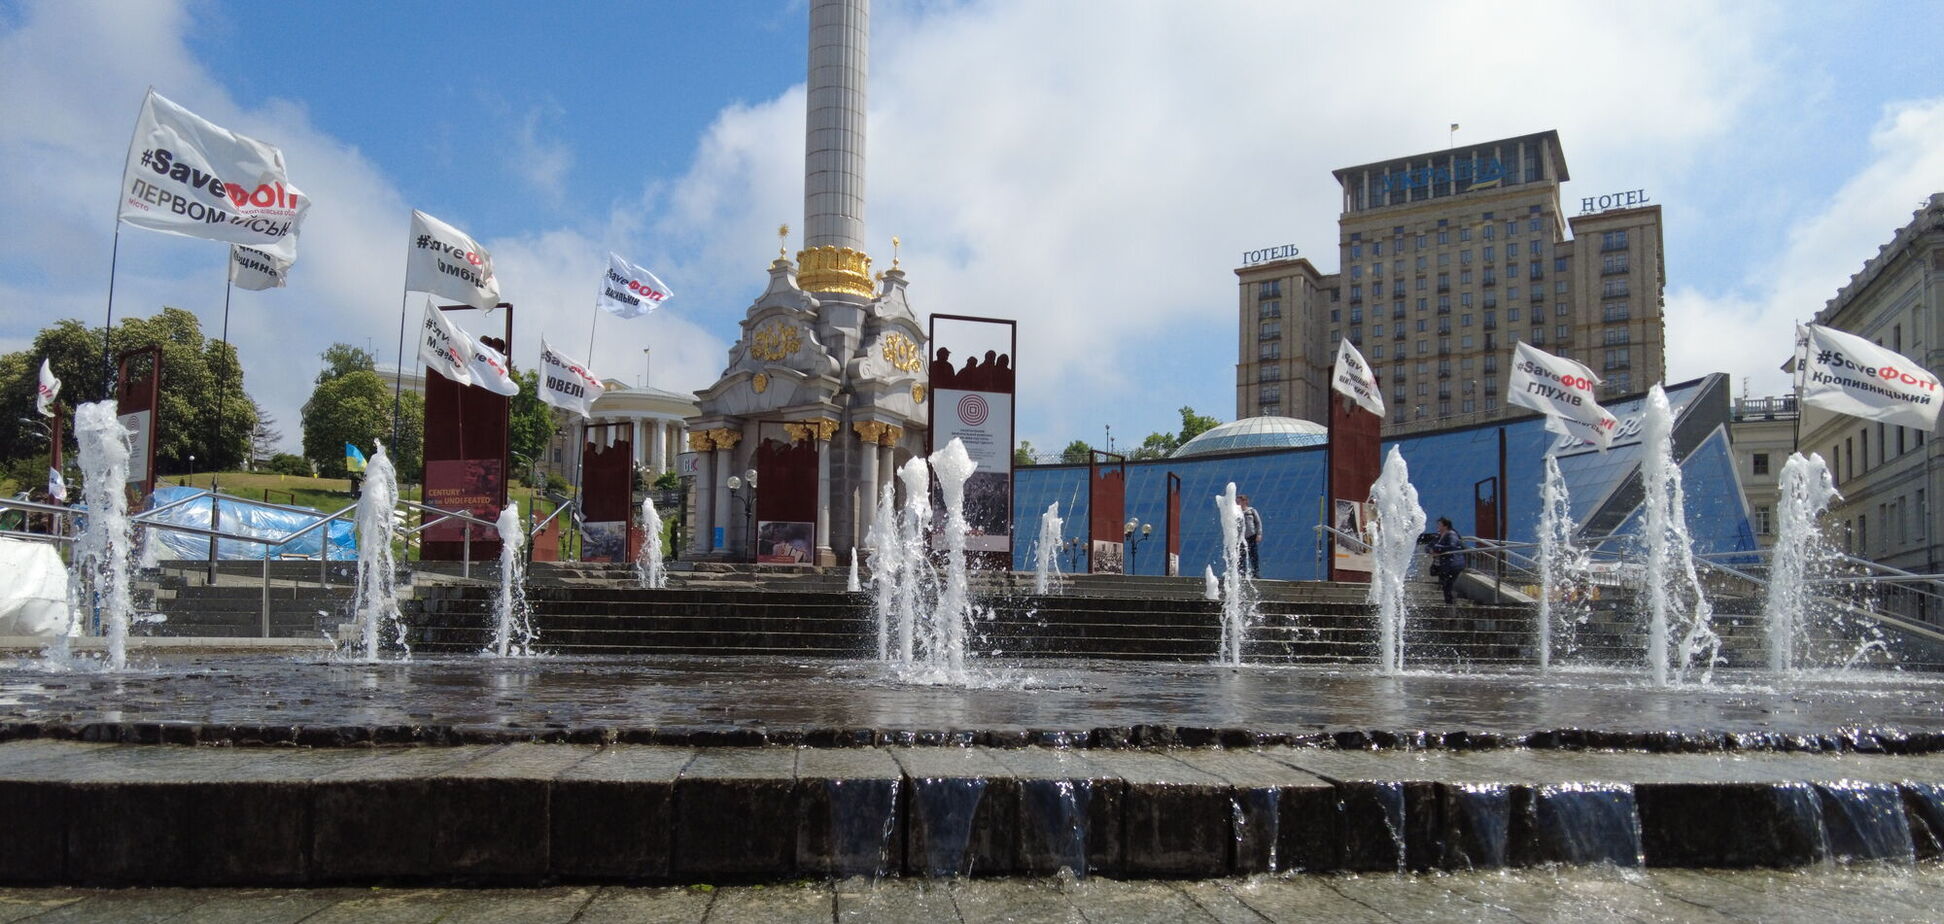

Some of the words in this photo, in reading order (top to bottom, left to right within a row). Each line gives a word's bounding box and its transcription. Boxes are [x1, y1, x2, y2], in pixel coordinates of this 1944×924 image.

[1581, 189, 1650, 212] HOTEL
[1243, 244, 1299, 264] ГОТЕЛЬ
[1517, 360, 1594, 392] #SaveФОП
[1817, 350, 1936, 392] #SaveФОП
[1527, 381, 1582, 407] ГЛУХІВ
[1812, 371, 1931, 405] Кропивницький
